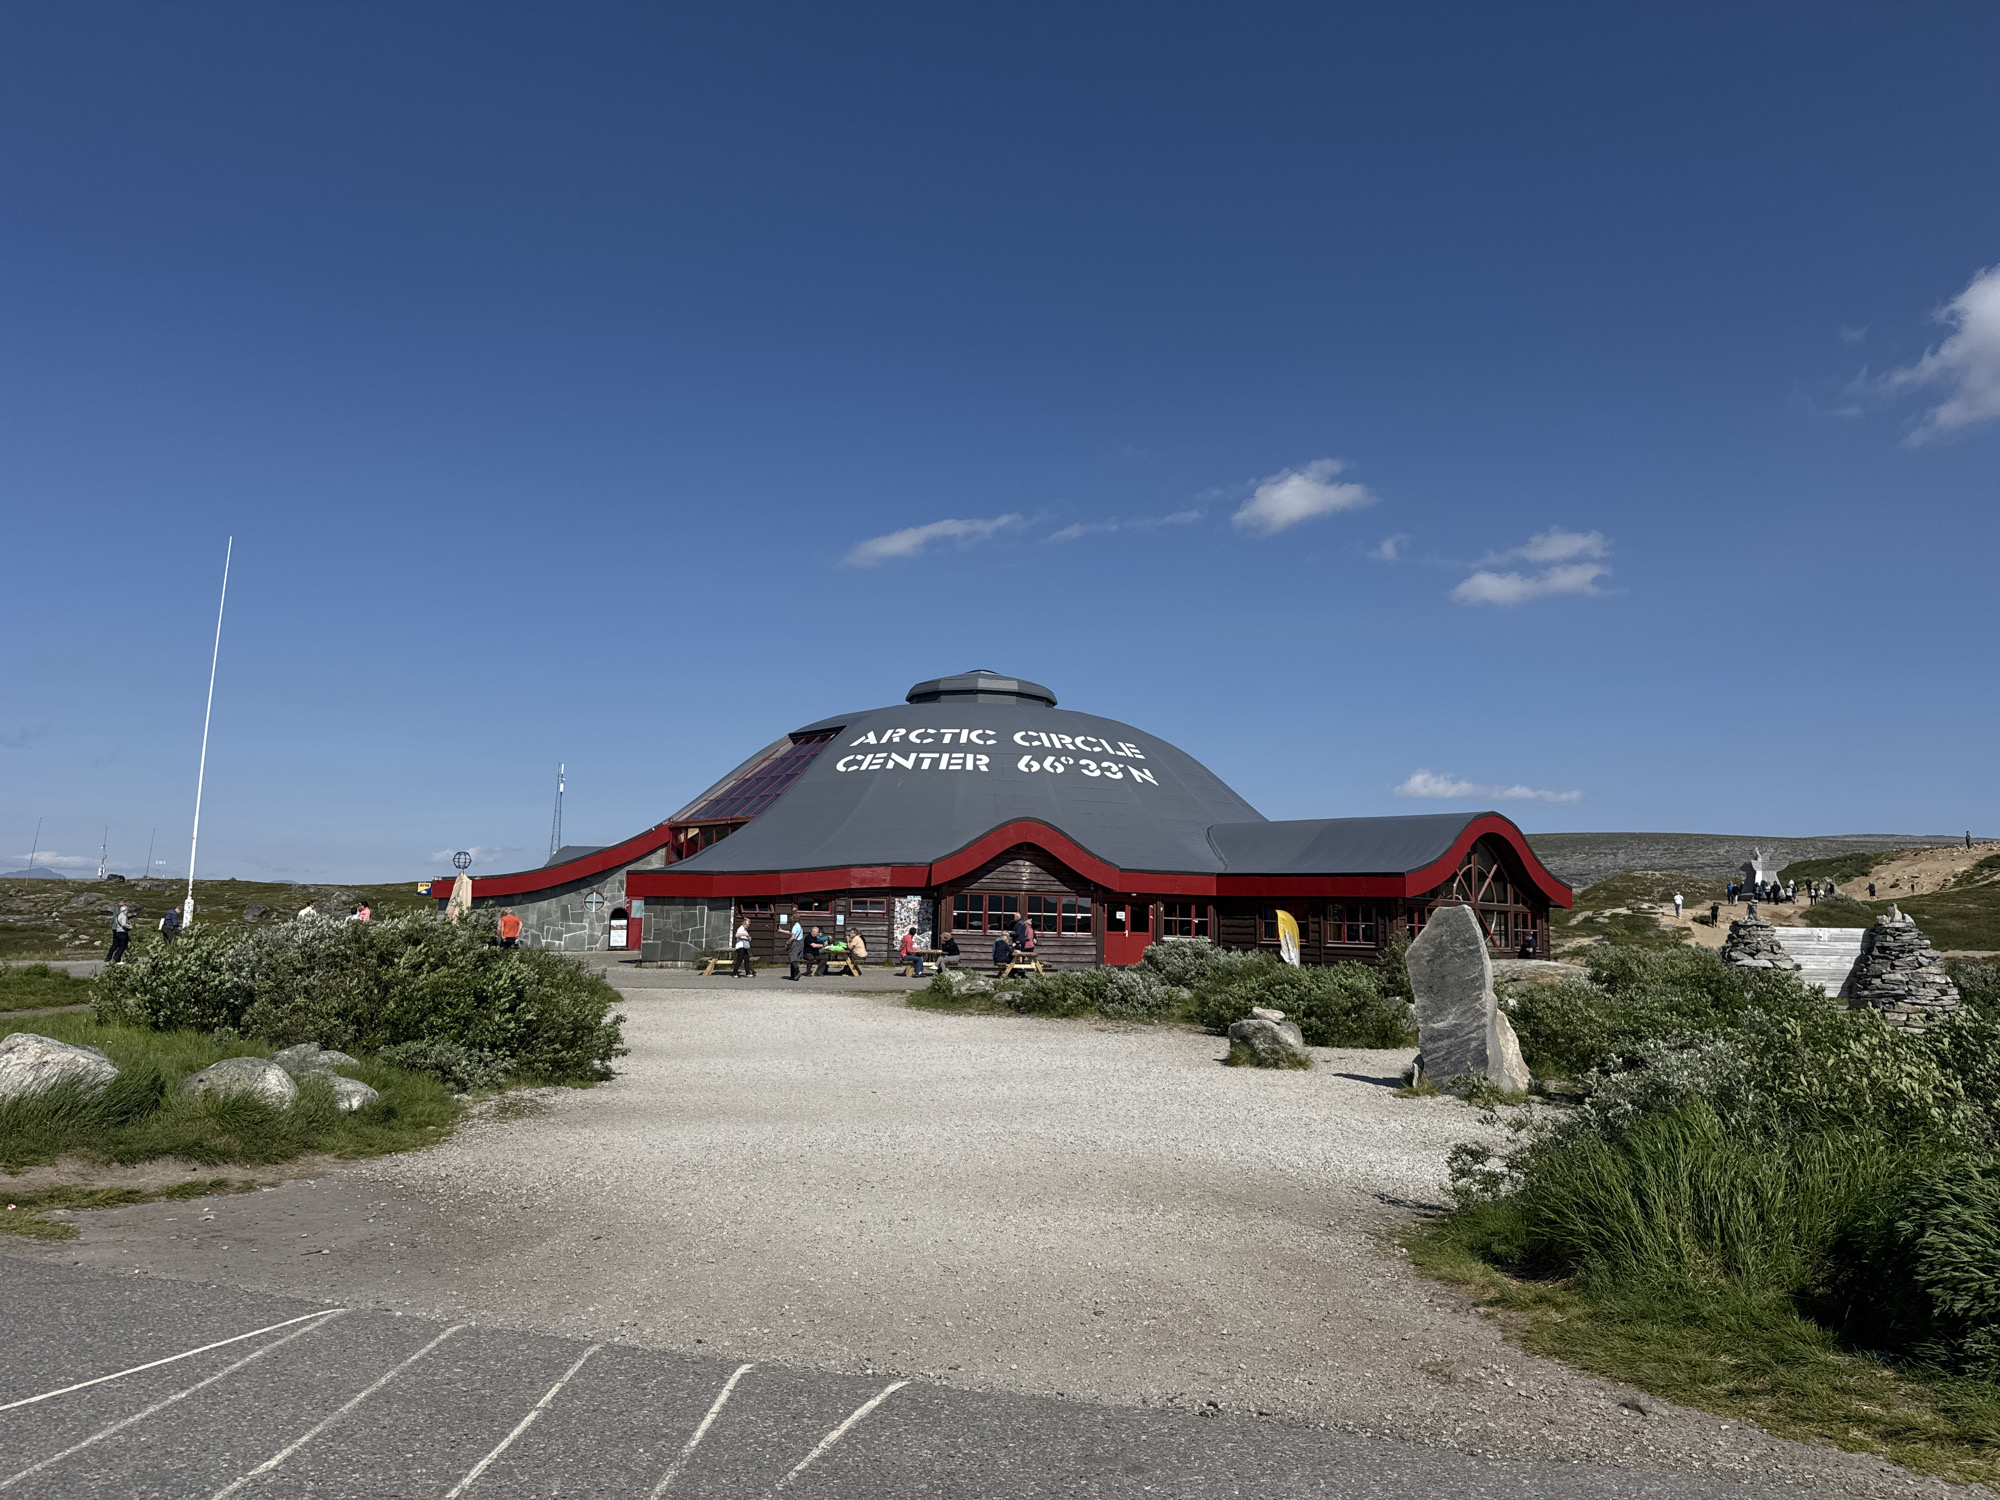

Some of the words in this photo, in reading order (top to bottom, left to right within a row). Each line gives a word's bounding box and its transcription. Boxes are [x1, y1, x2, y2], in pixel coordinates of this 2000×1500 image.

[849, 728, 998, 746] ARCTIC
[1013, 731, 1146, 760] CIRCLE
[835, 752, 990, 772] CENTER
